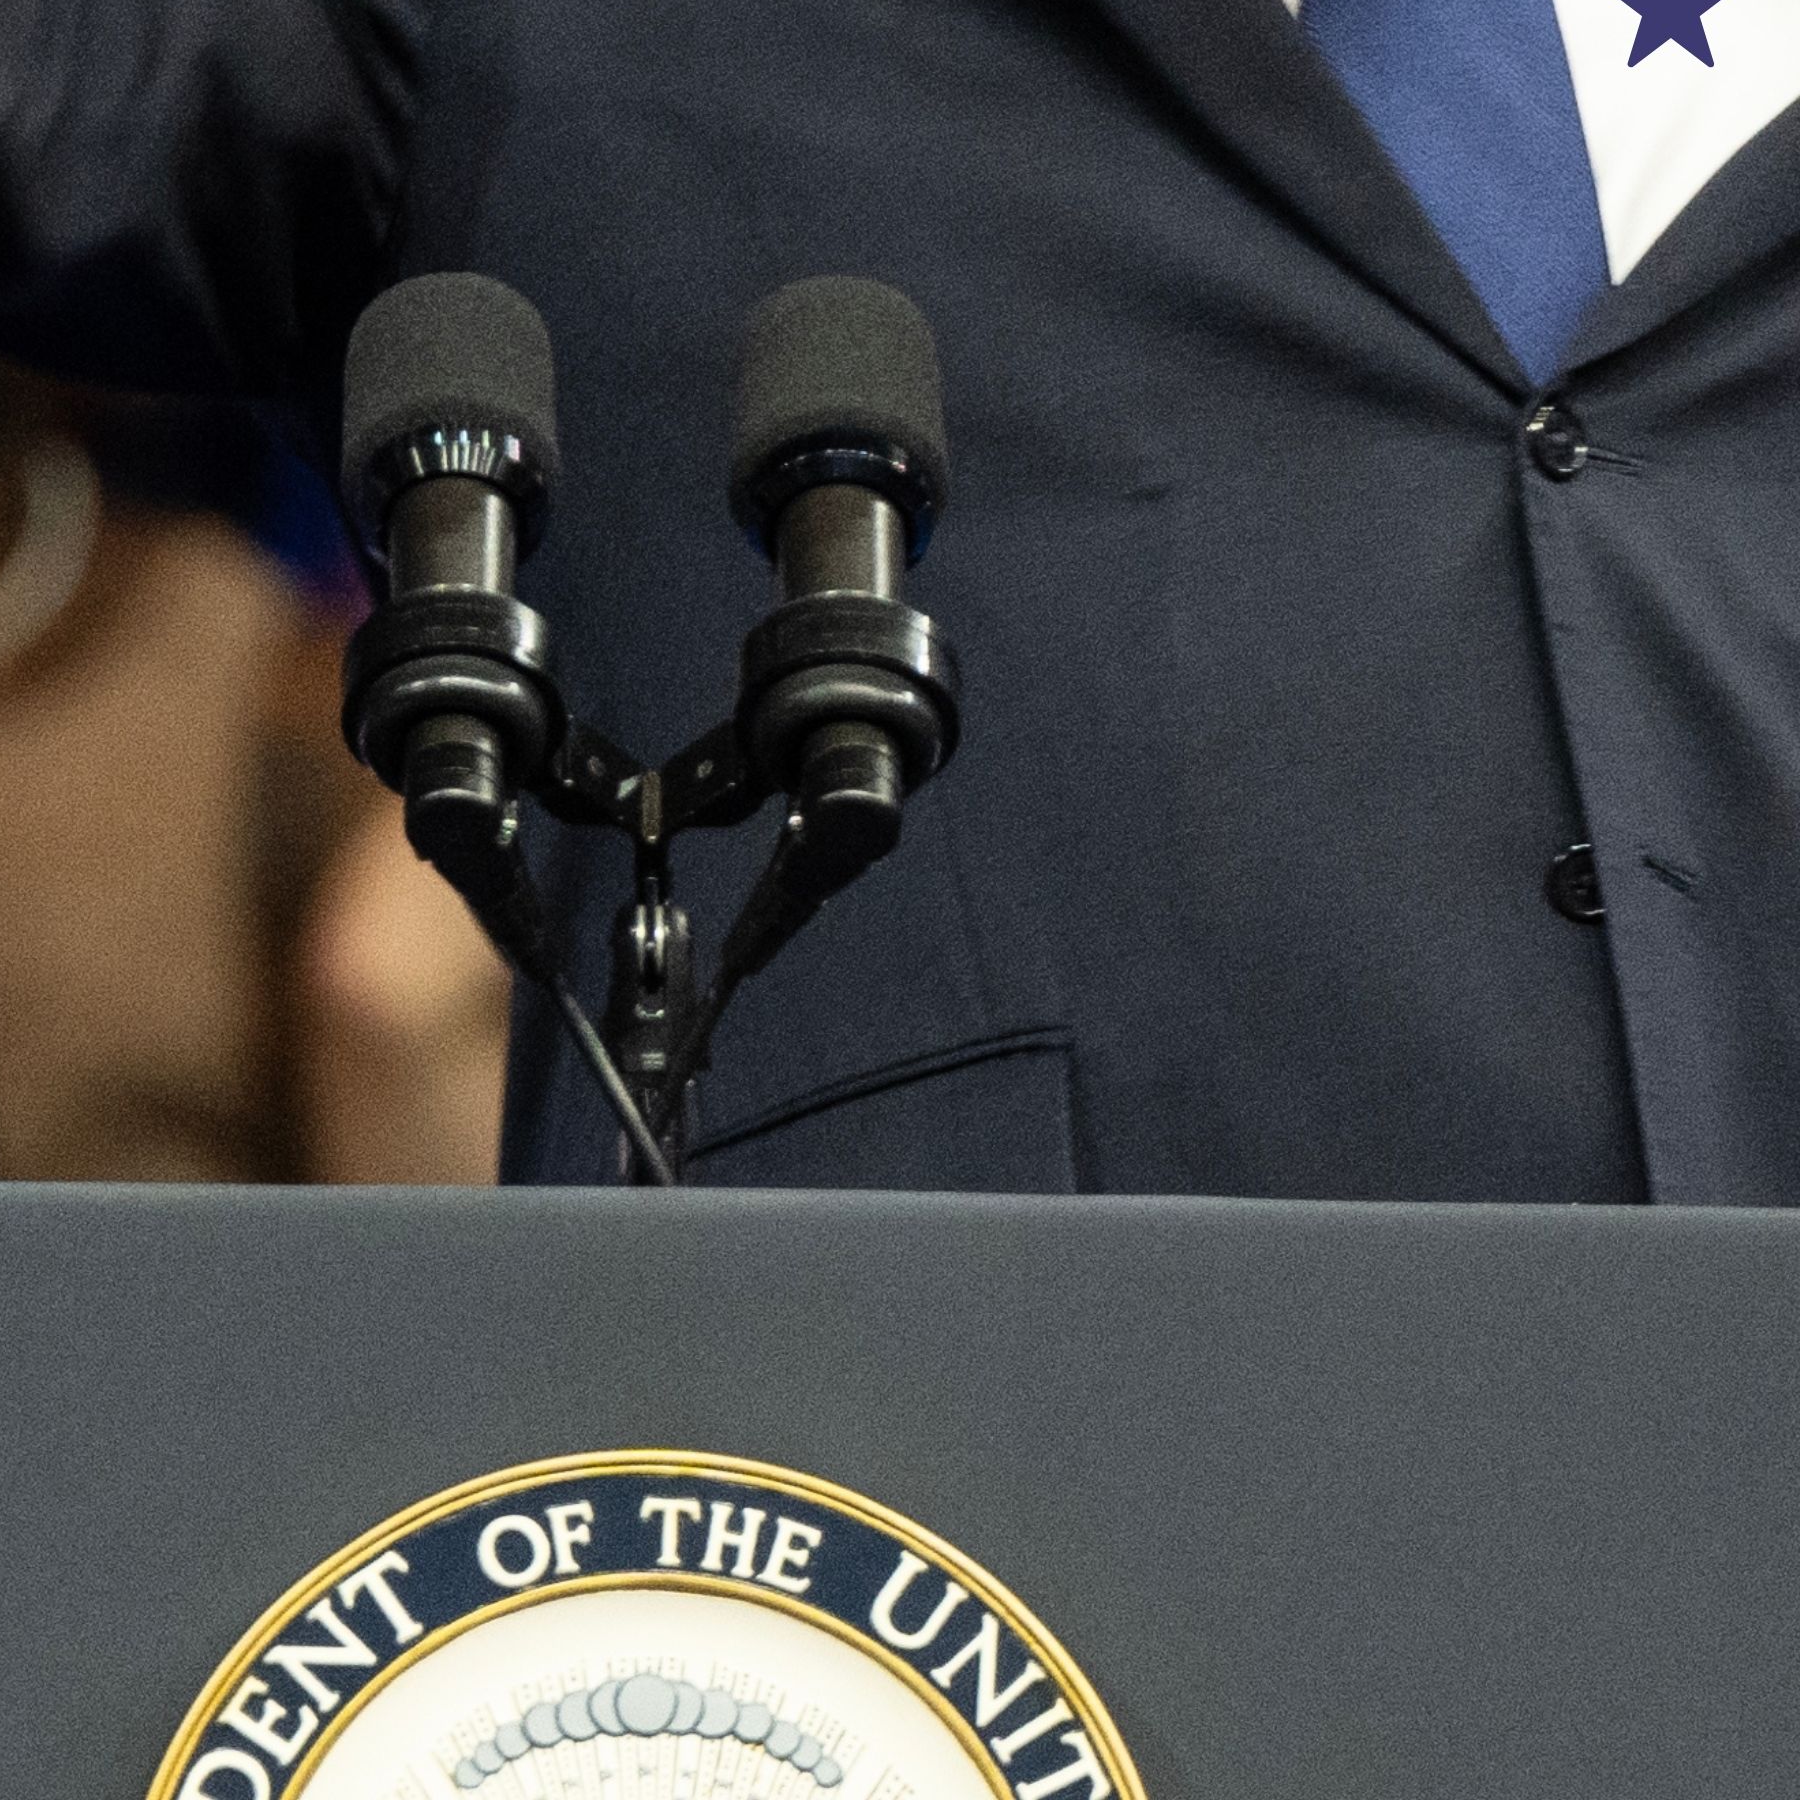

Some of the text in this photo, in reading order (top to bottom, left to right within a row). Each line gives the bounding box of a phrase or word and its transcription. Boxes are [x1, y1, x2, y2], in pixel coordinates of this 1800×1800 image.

[477, 1500, 595, 1588] OF
[640, 1497, 822, 1593] THE
[869, 1550, 1111, 1800] UNIT
